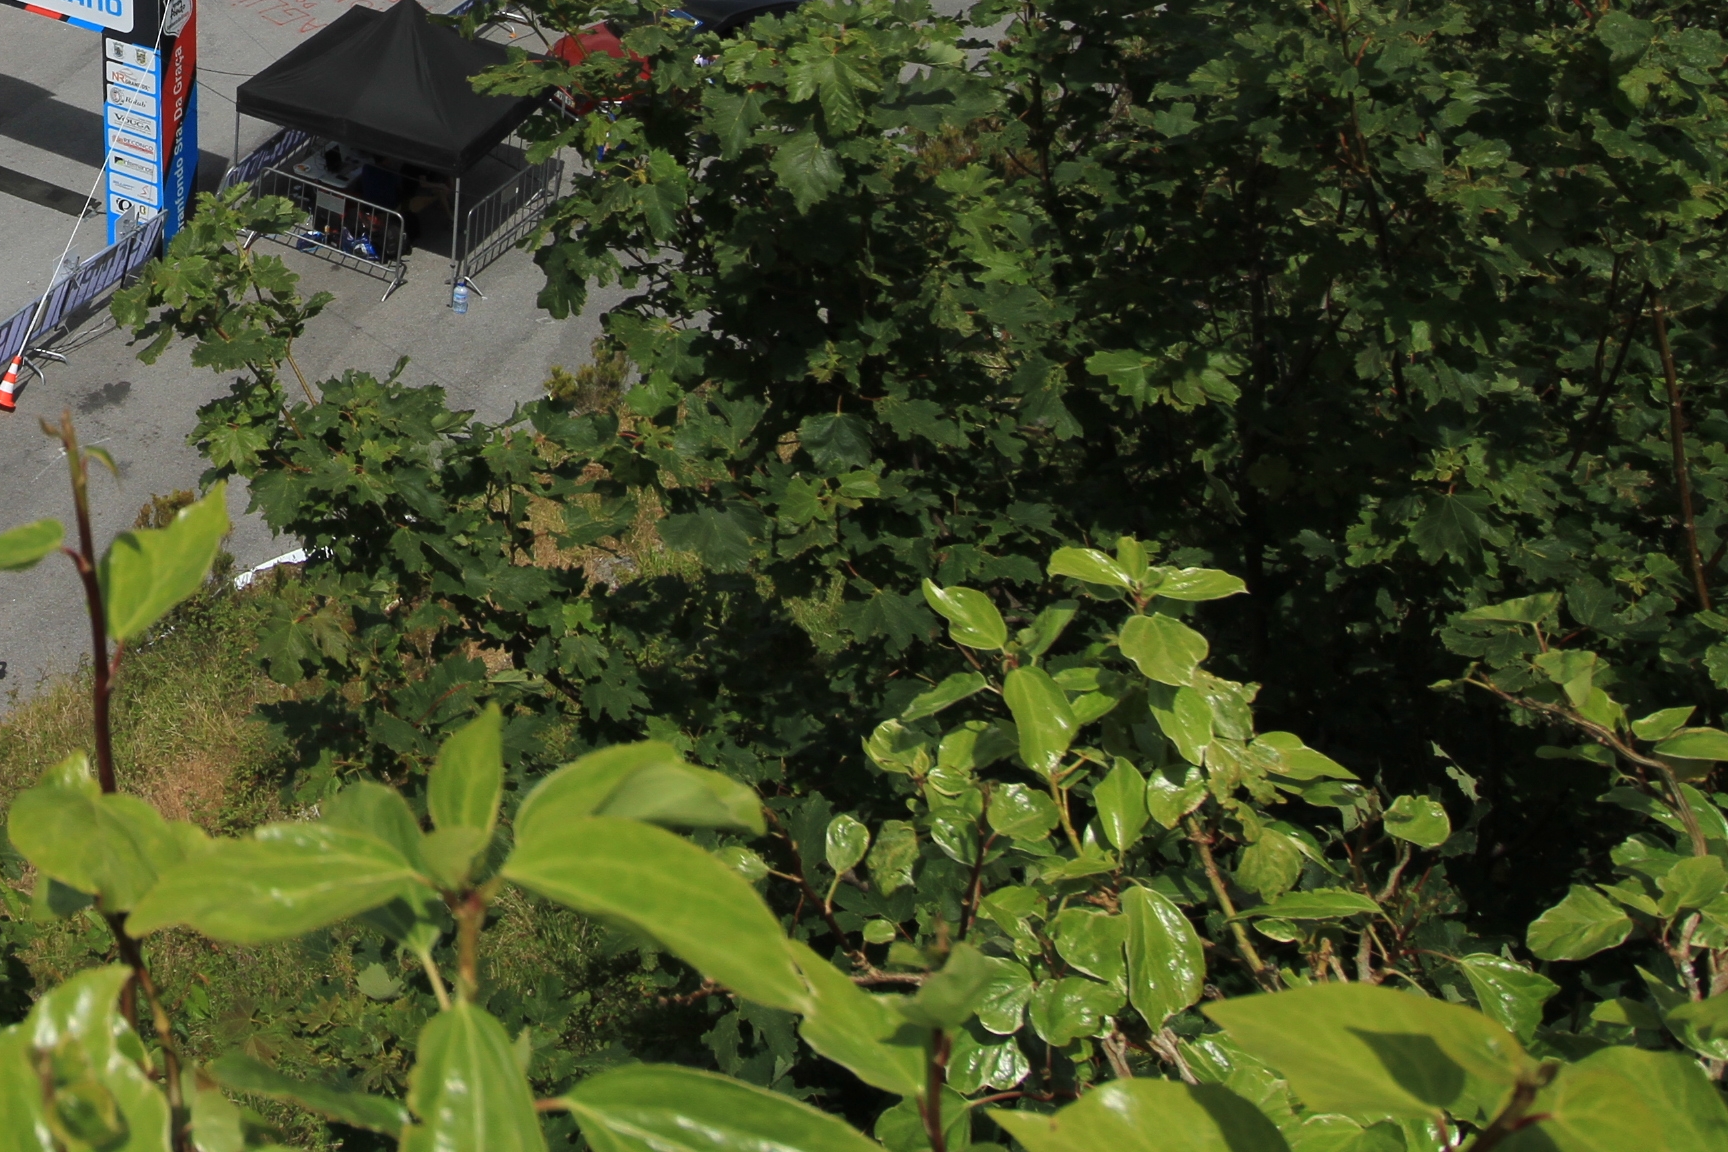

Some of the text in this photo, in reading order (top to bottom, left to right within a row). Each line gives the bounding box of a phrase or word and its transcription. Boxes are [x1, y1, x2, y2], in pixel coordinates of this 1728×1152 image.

[173, 45, 184, 96] Graça
[173, 96, 183, 123] Da
[173, 157, 185, 233] ranfondo
